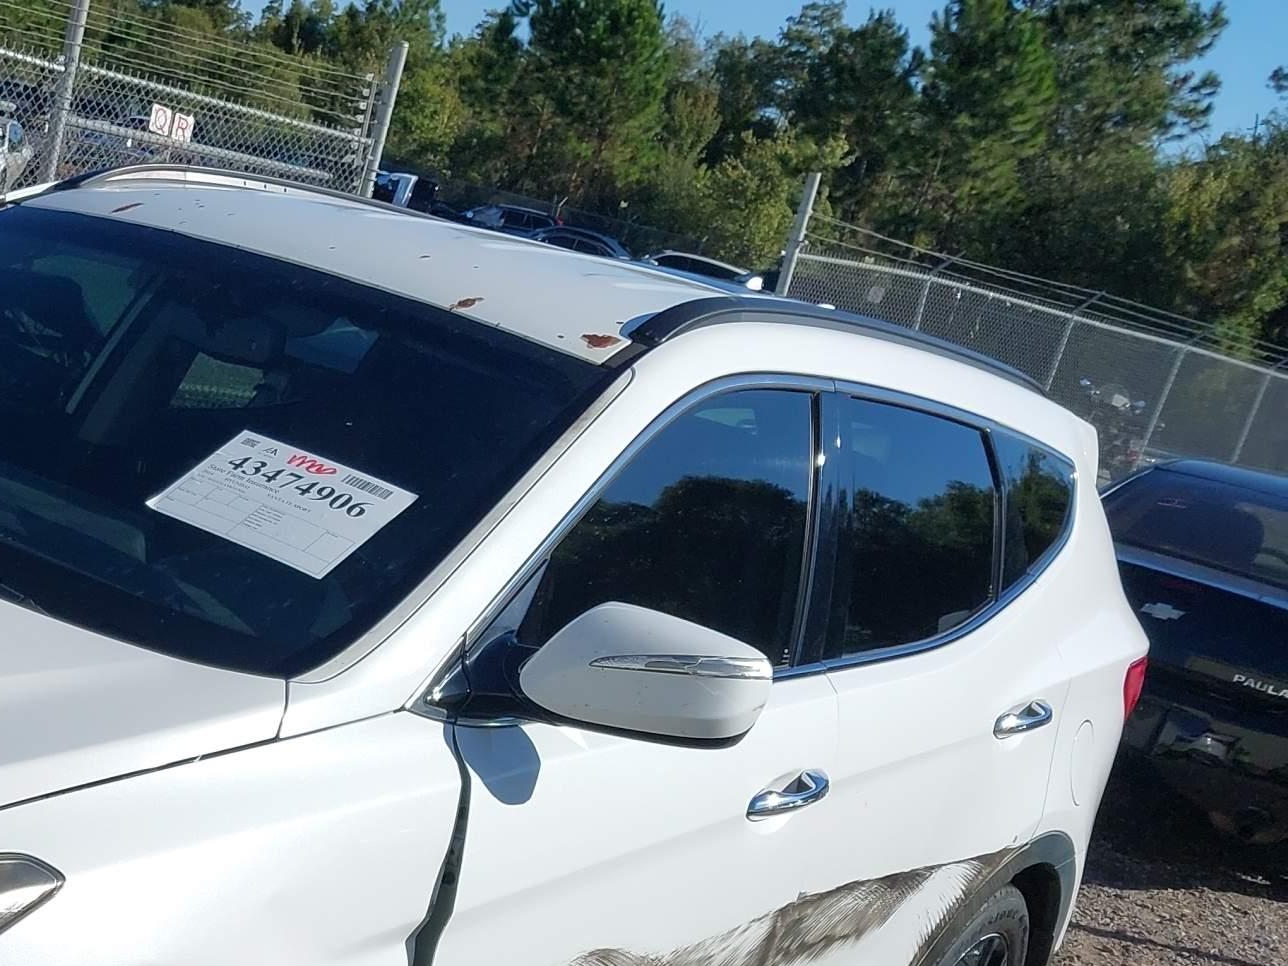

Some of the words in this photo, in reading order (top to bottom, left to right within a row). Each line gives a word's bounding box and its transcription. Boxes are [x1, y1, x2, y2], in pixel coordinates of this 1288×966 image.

[154, 108, 168, 134] Q
[176, 115, 188, 139] R
[226, 470, 245, 481] Farm
[228, 456, 375, 518] 43474906
